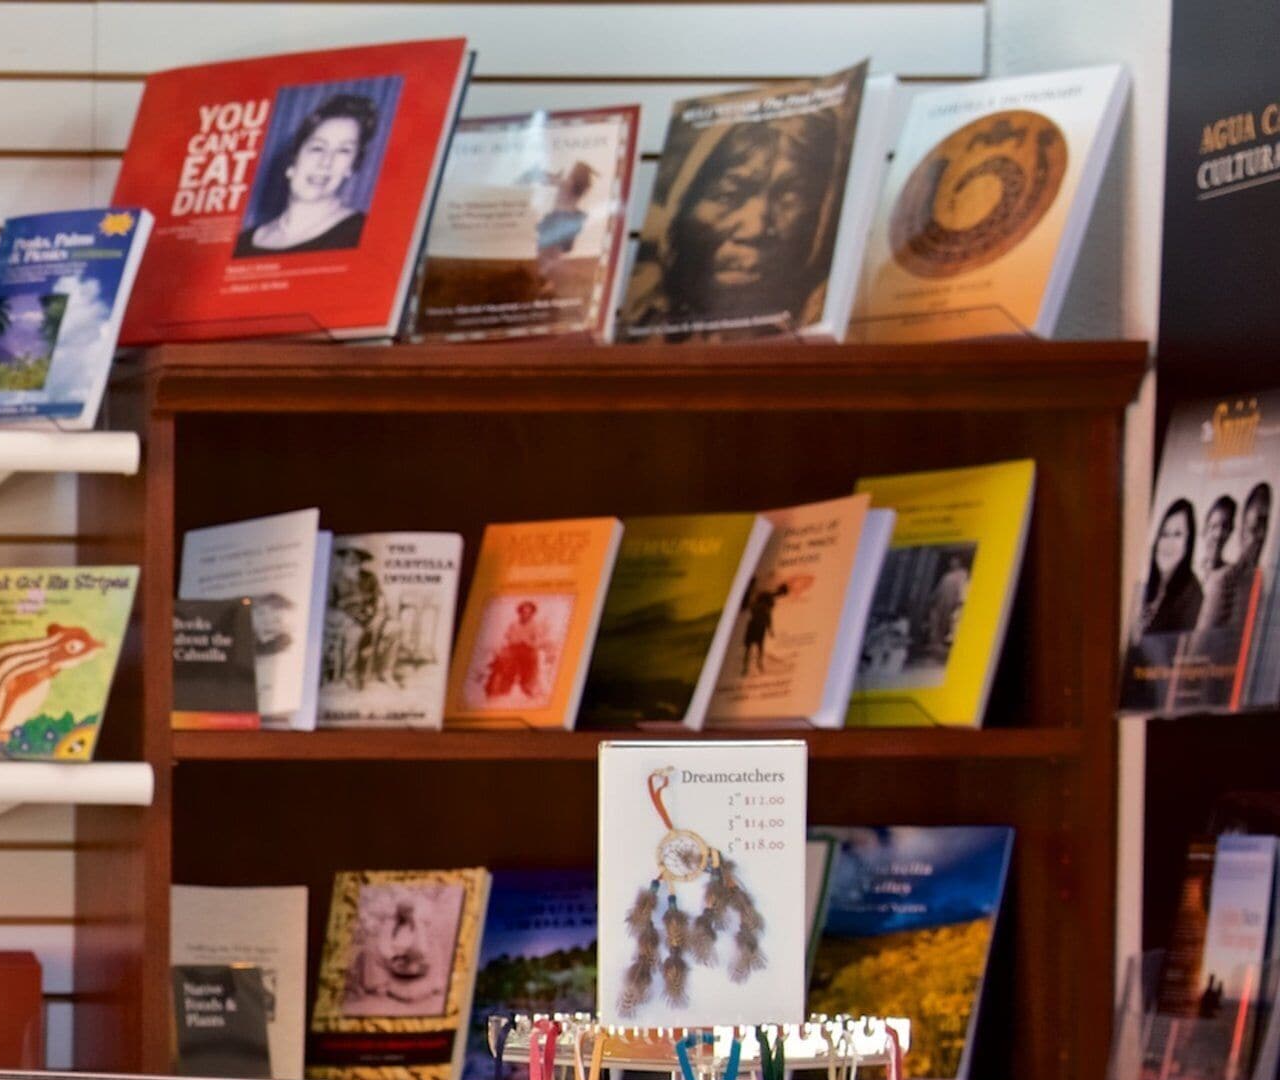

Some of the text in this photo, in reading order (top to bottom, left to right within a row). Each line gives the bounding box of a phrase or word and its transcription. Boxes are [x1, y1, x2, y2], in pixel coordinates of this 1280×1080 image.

[200, 99, 271, 131] YOU
[1200, 108, 1255, 155] AGUA
[188, 128, 263, 156] CAN'T
[181, 154, 255, 188] EAT
[171, 184, 246, 217] DIRT
[386, 543, 417, 554] THE
[384, 559, 456, 571] CAHUILLA
[11, 575, 37, 592] Got
[41, 575, 65, 592] His
[68, 573, 125, 592] Stripes
[384, 573, 443, 586] INDIANS
[210, 633, 232, 647] the
[174, 648, 227, 663] Cahuilla
[680, 768, 785, 786] Dreamcatchers
[744, 792, 785, 807] $12.00
[744, 814, 785, 830] $14.00
[744, 837, 785, 851] $18.00
[183, 981, 223, 996] Native
[184, 997, 237, 1012] Foods &
[185, 1012, 225, 1028] Plants
